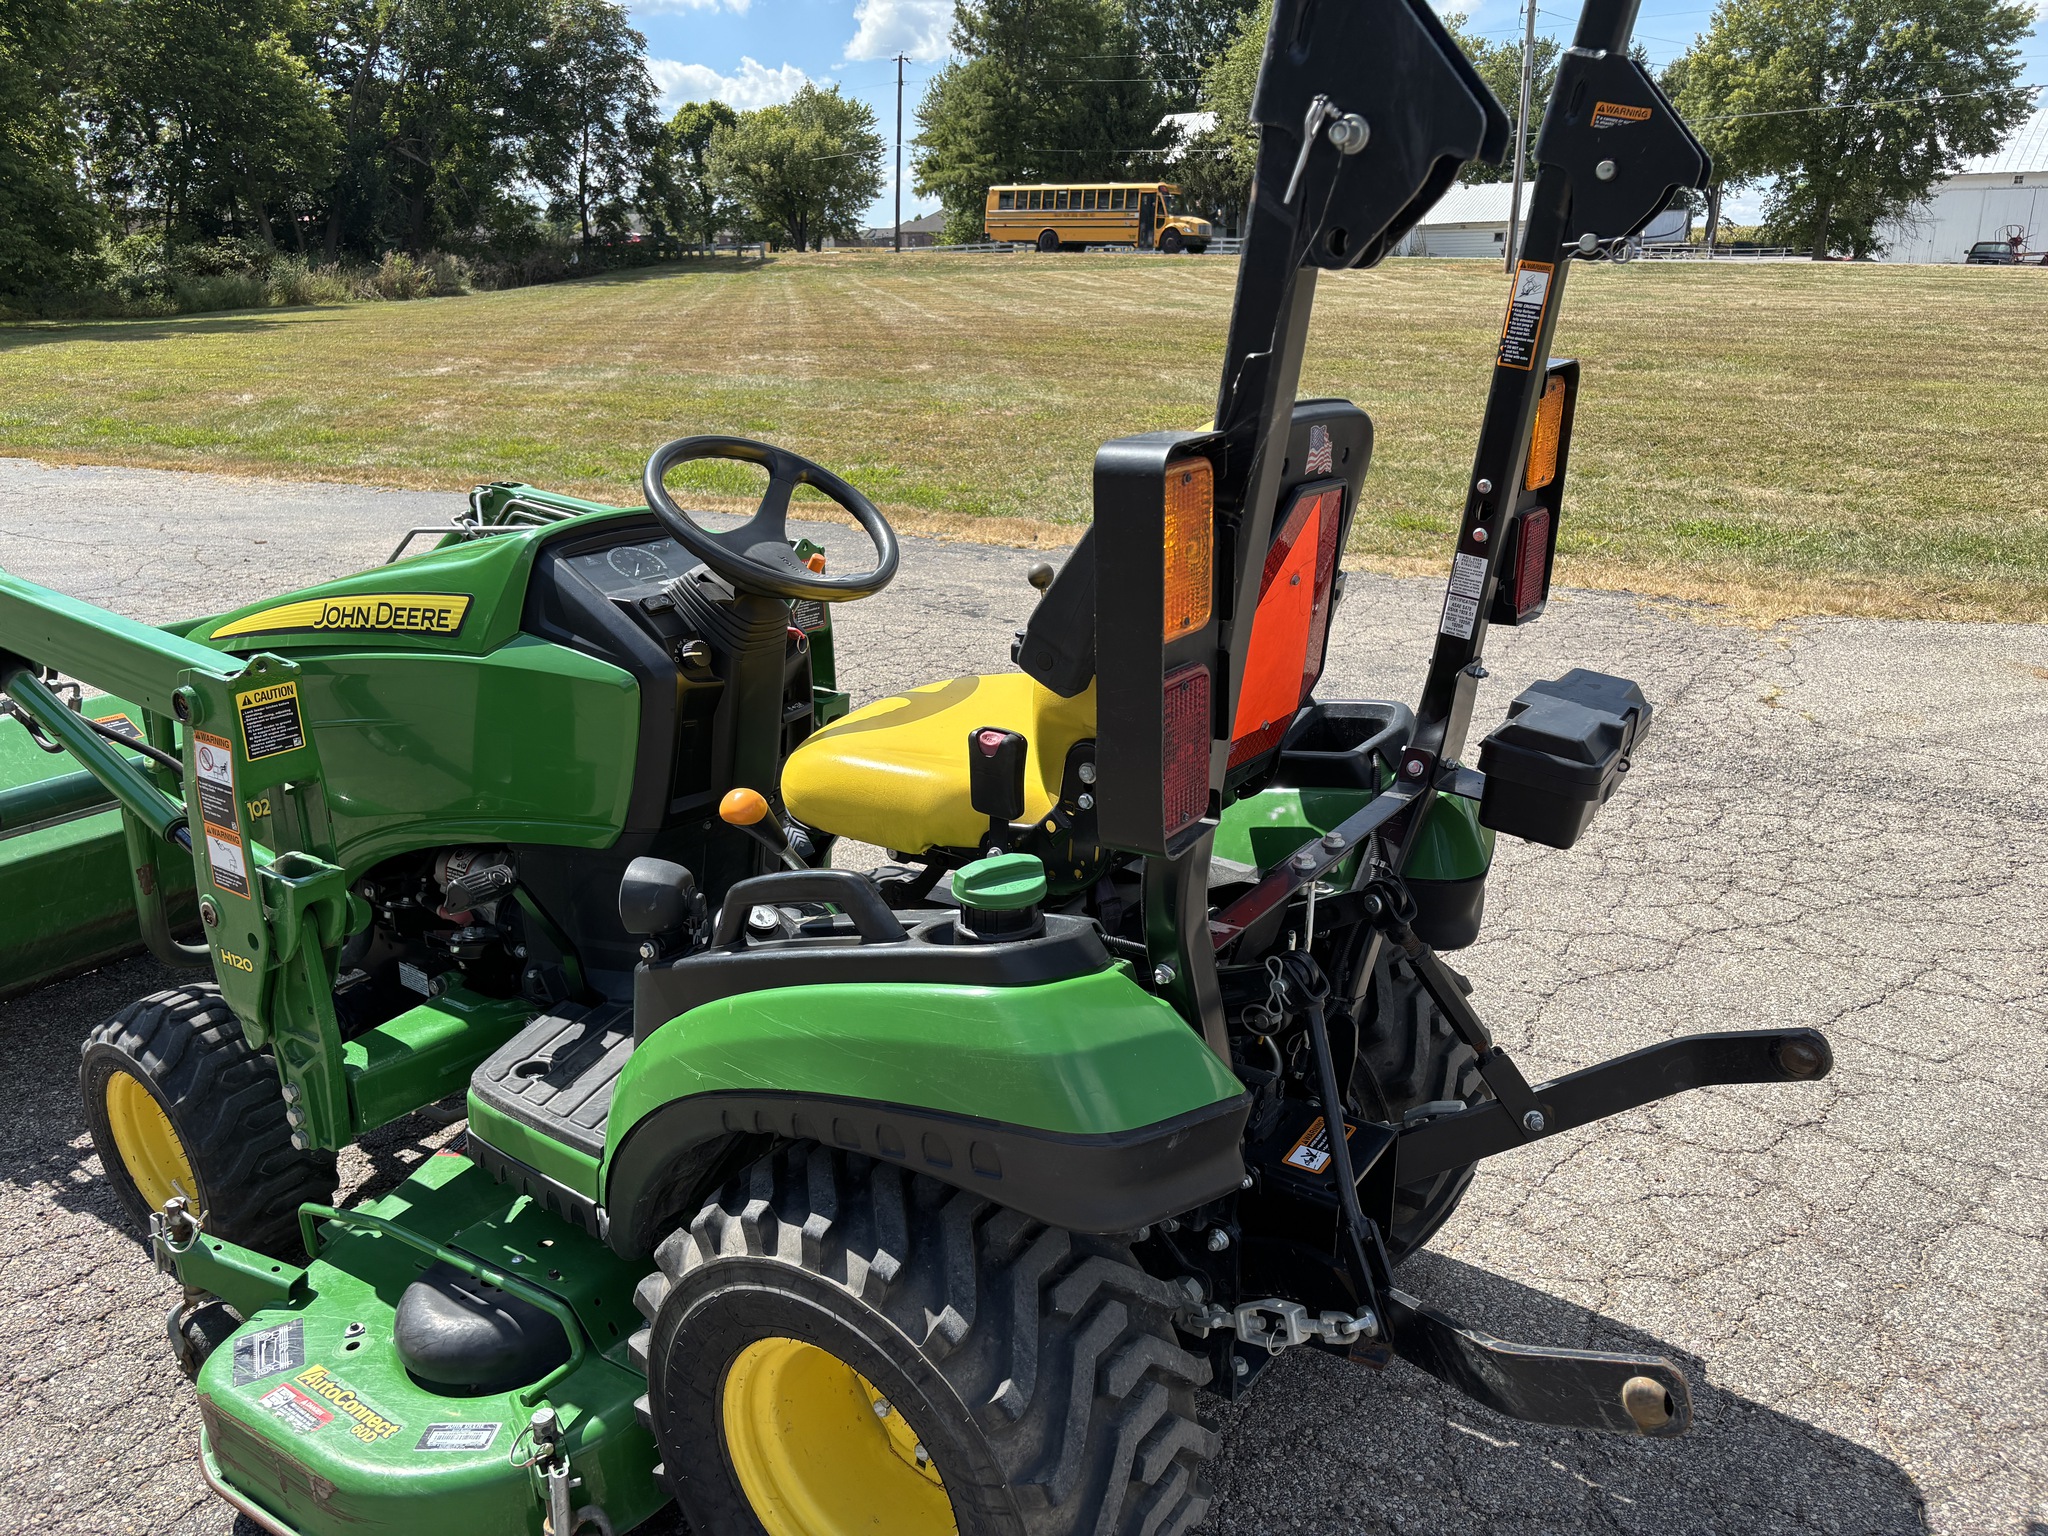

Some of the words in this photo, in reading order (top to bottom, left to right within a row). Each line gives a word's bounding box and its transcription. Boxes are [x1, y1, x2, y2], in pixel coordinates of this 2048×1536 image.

[1606, 105, 1648, 118] WARNING
[1527, 262, 1552, 272] WARNING
[314, 603, 371, 625] JOHN
[376, 602, 451, 628] DEERE
[254, 685, 294, 703] CAUTION
[200, 732, 230, 749] WARNING
[210, 829, 240, 845] WARNING
[220, 949, 253, 973] H120
[297, 1369, 402, 1440] AutoConnect
[350, 1423, 378, 1444] 60D
